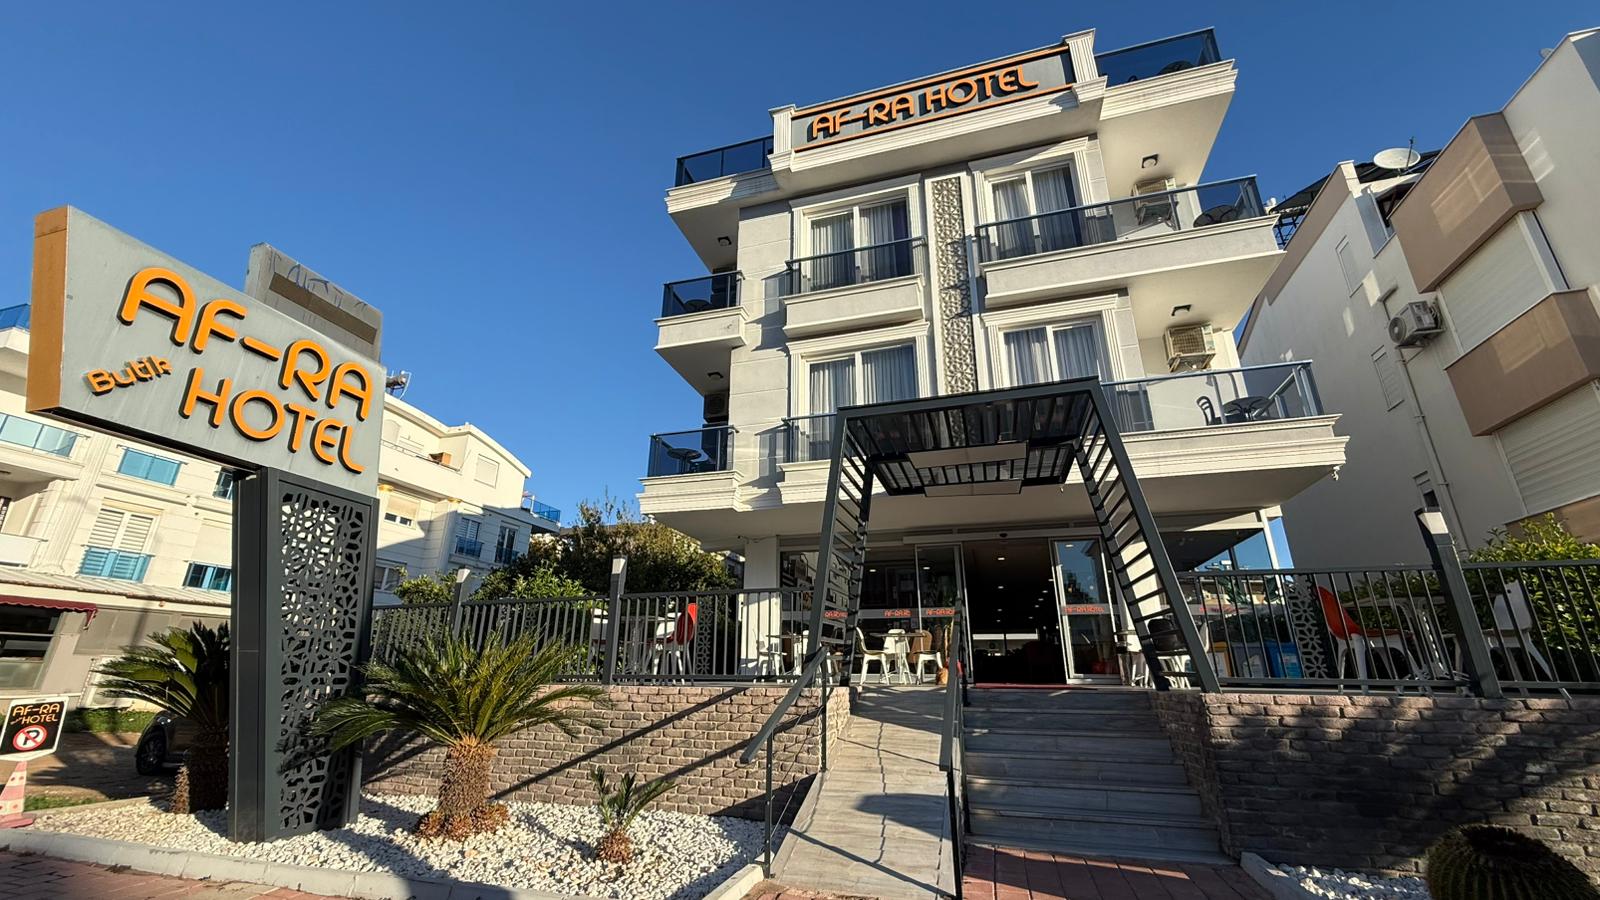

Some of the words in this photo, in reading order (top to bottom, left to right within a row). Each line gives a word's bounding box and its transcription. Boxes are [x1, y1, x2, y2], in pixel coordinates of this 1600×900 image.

[812, 94, 914, 138] AF-RA
[926, 65, 1039, 107] HOTEL
[118, 267, 374, 421] AF-RA
[85, 355, 173, 395] Butik
[181, 367, 366, 474] HOTEL
[12, 703, 60, 716] AF-RA
[21, 714, 58, 724] HOTEL
